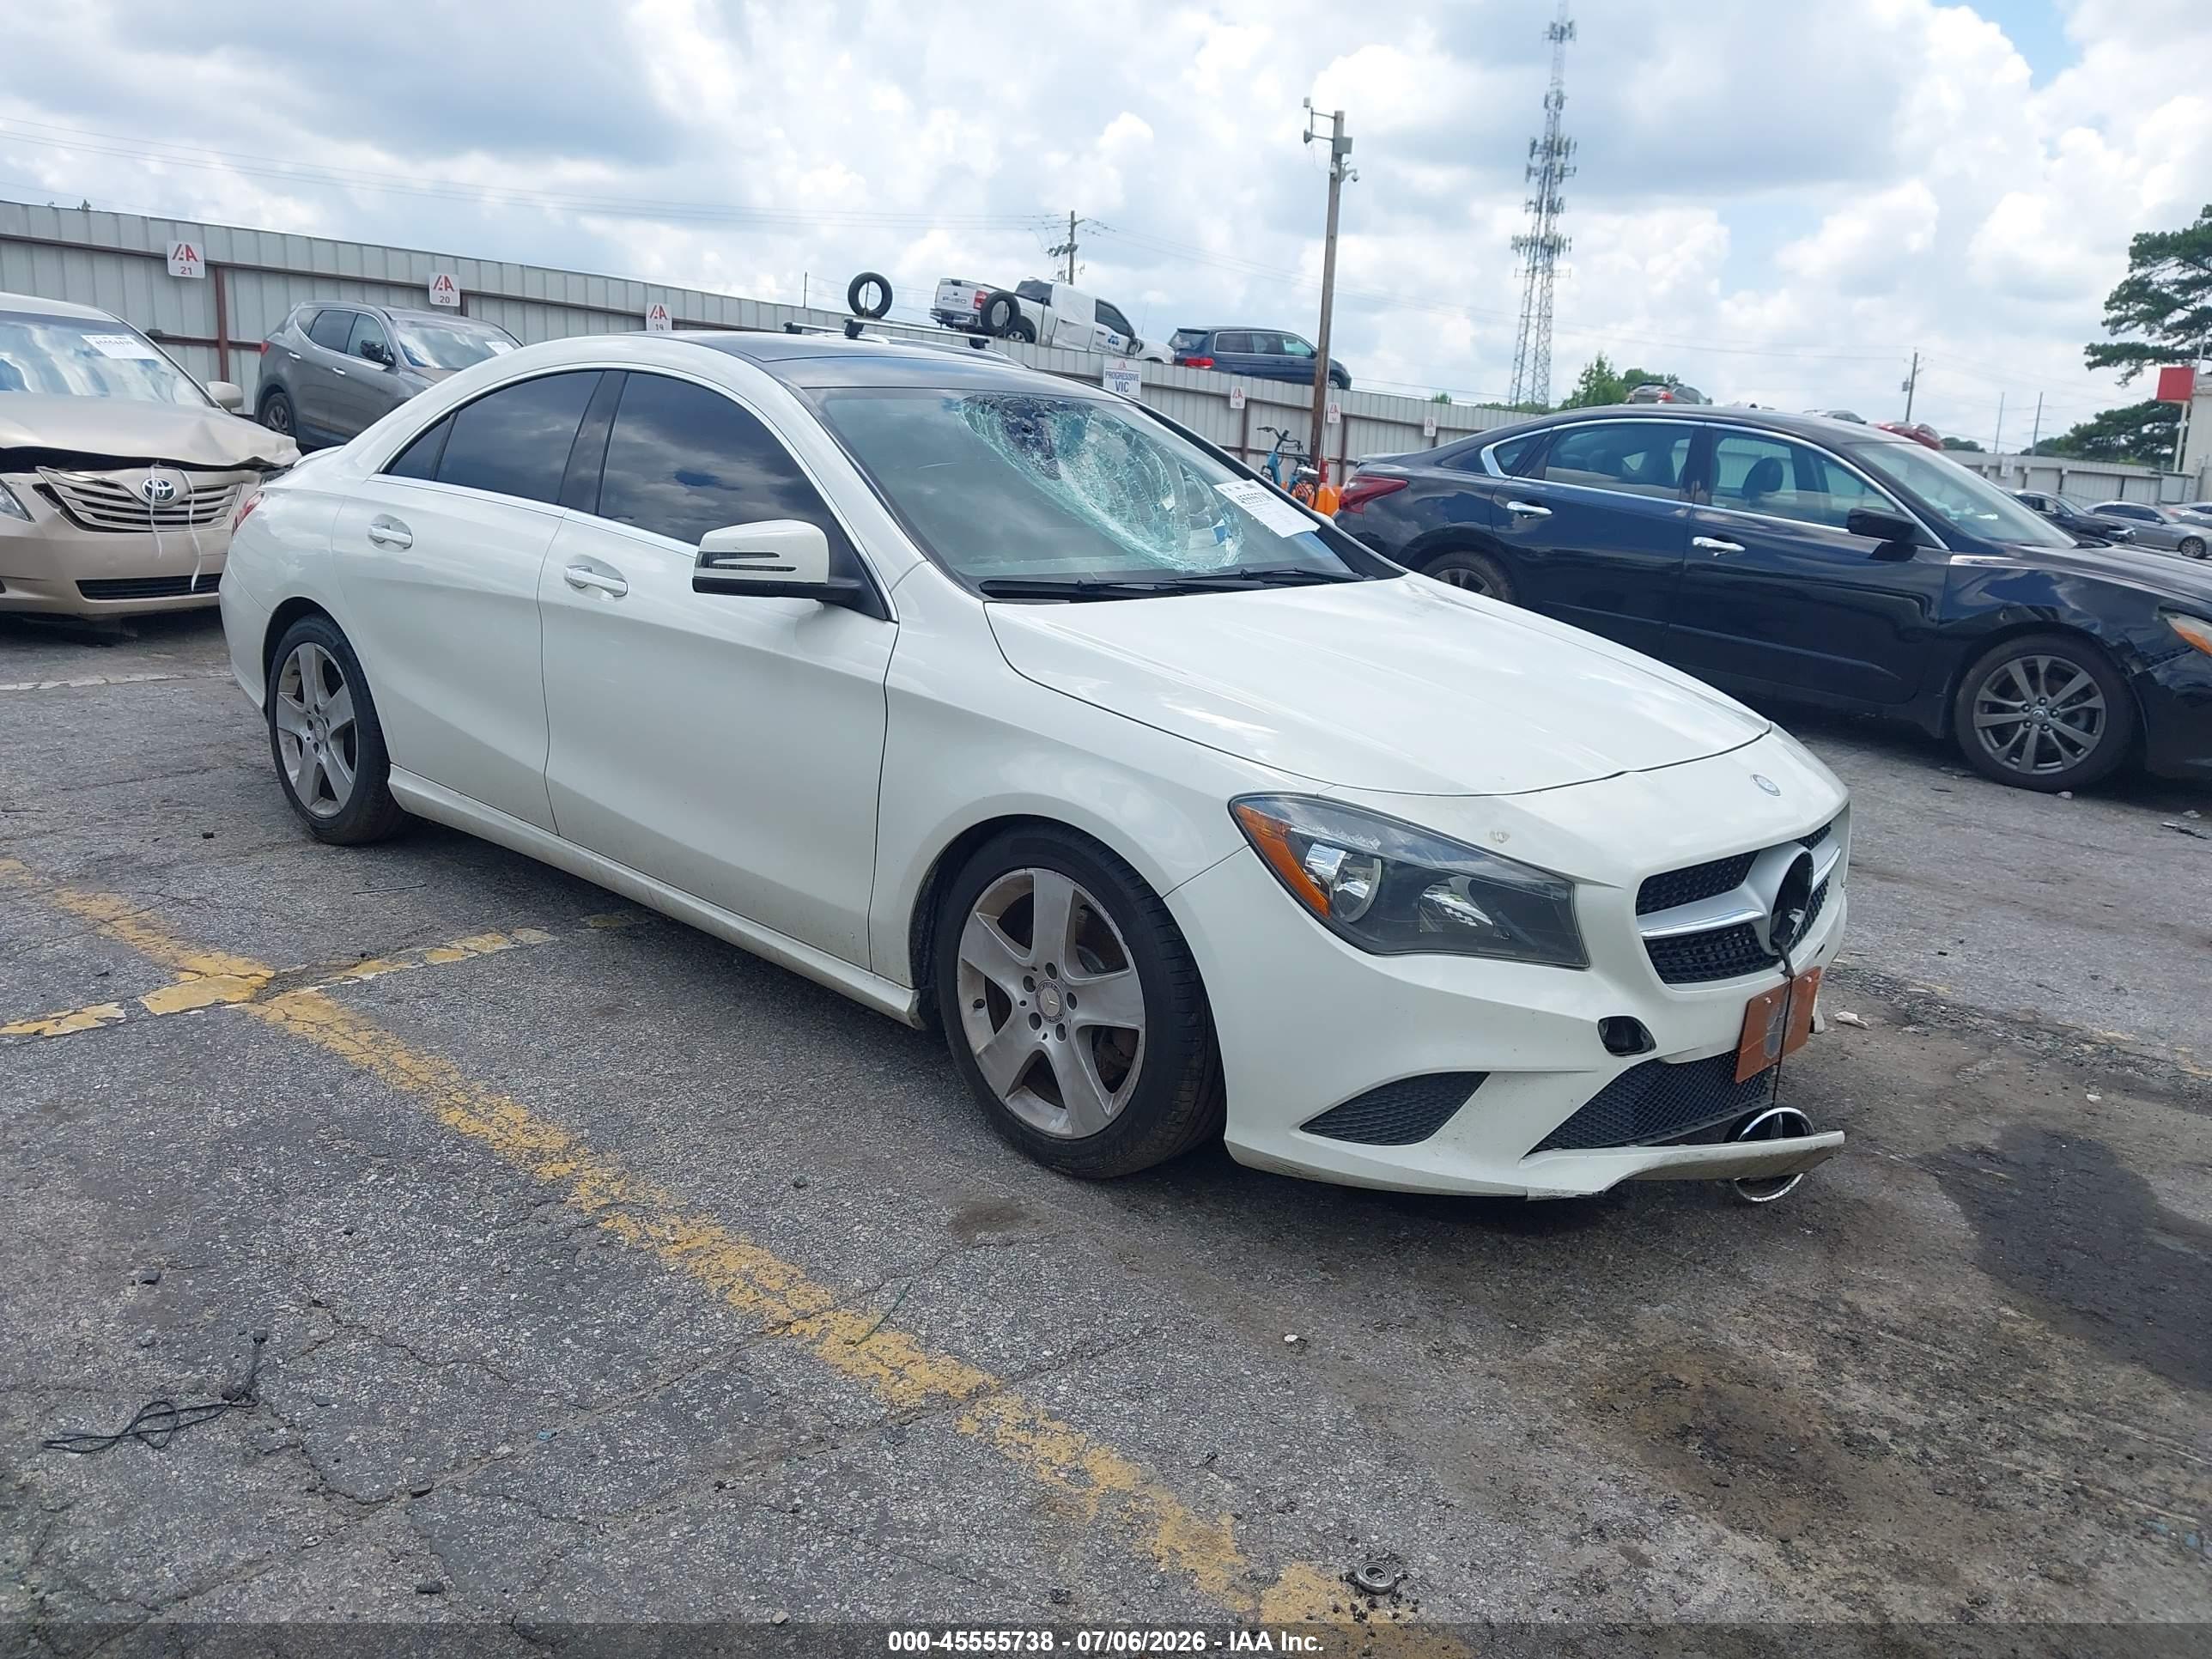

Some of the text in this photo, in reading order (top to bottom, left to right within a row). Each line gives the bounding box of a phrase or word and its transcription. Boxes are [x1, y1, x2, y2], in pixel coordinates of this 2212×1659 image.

[180, 266, 192, 276] 21
[1105, 370, 1140, 381] PROGRESSIVE
[1115, 380, 1129, 392] VIC
